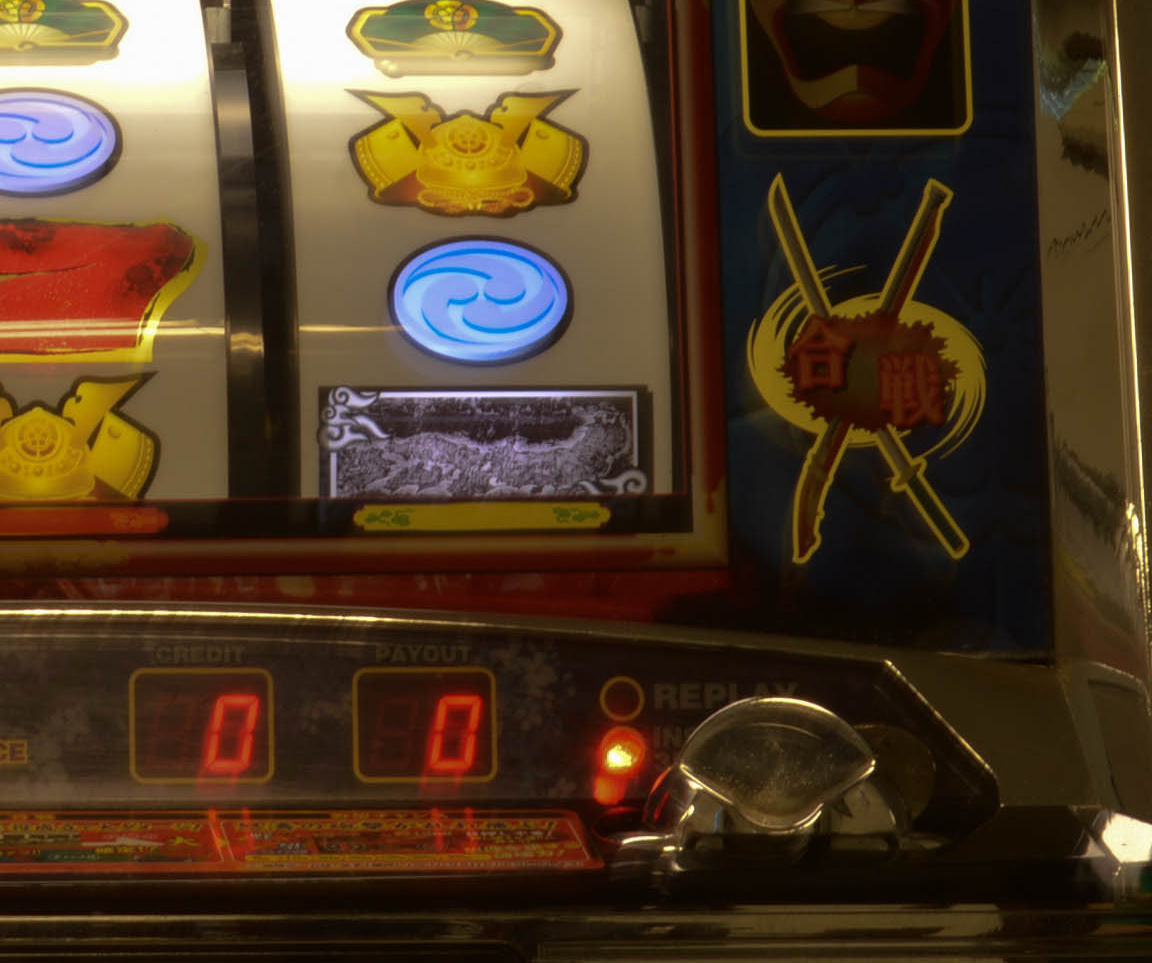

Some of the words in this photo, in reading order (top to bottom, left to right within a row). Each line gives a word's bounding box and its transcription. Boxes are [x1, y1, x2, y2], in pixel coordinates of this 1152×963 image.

[153, 644, 247, 663] CREDIT
[376, 644, 473, 663] PAYOUT
[204, 693, 260, 774] 0
[429, 693, 483, 774] 0
